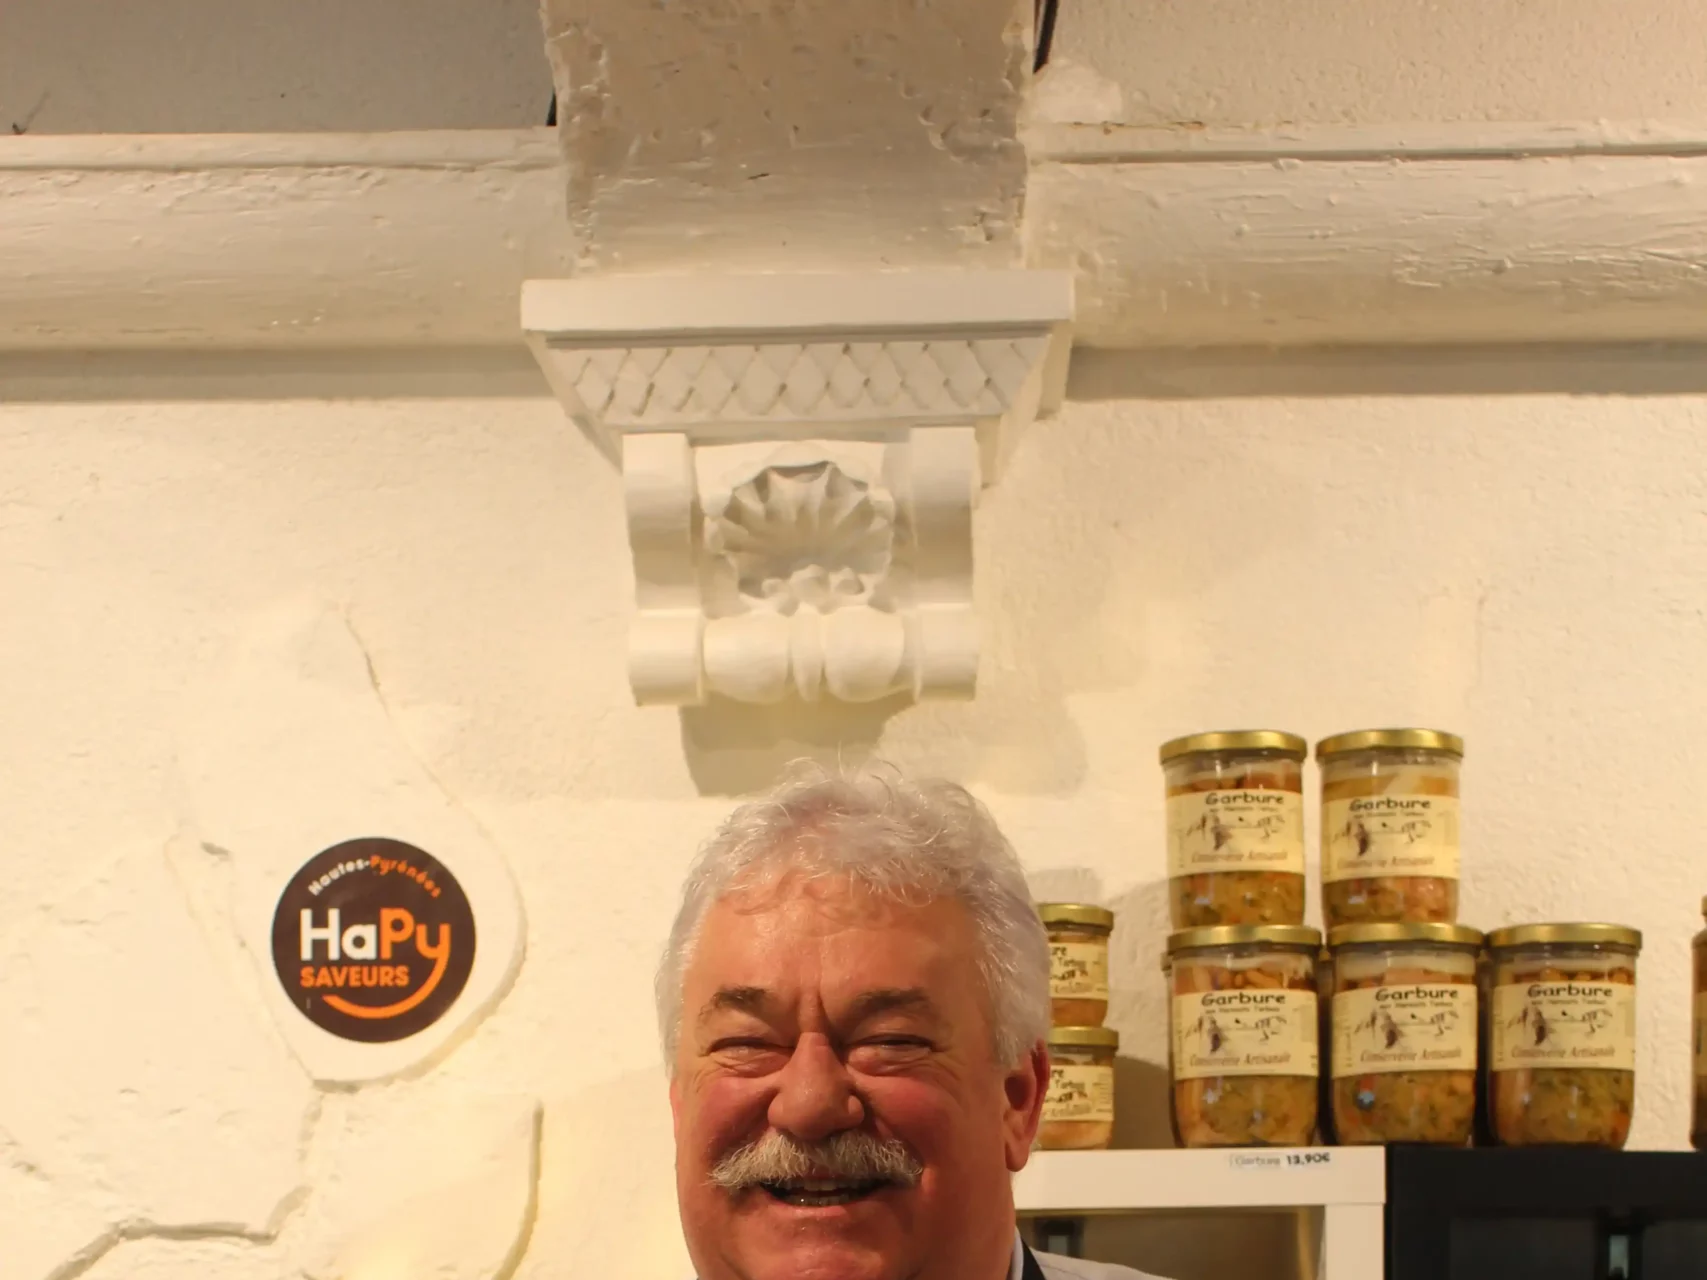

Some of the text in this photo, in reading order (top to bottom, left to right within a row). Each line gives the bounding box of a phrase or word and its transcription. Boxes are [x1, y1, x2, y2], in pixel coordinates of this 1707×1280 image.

[1205, 791, 1284, 805] Garbure
[1349, 797, 1431, 811] Garbure
[308, 855, 441, 897] Hautes-Pyrénées
[300, 965, 410, 987] SAVEURS
[1375, 986, 1459, 1002] Garbure
[1526, 983, 1613, 998] Garbure
[1201, 991, 1286, 1006] Garbure
